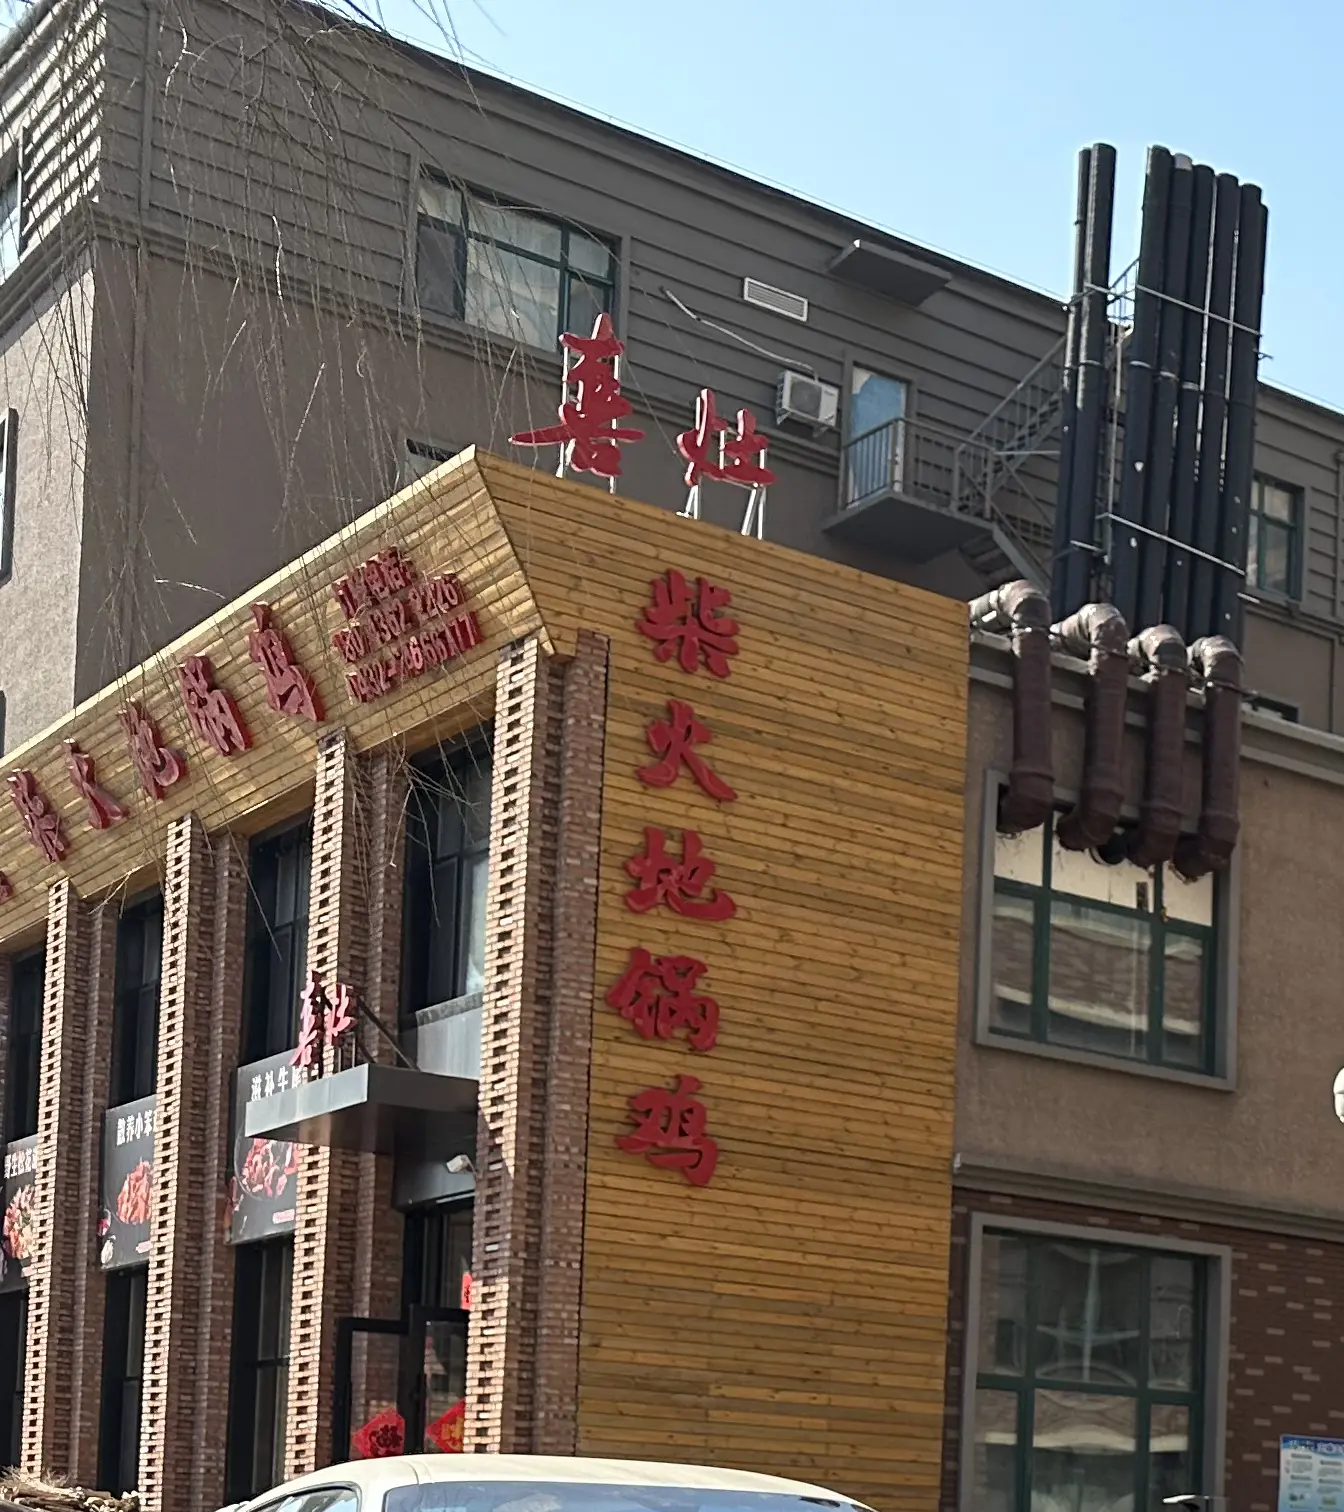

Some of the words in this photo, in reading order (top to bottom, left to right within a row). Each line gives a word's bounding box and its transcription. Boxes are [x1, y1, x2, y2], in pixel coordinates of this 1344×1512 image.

[507, 312, 778, 486] 喜灶
[0, 600, 325, 900] 柴火地锅鸡
[606, 568, 739, 1187] 柴火地锅鸡
